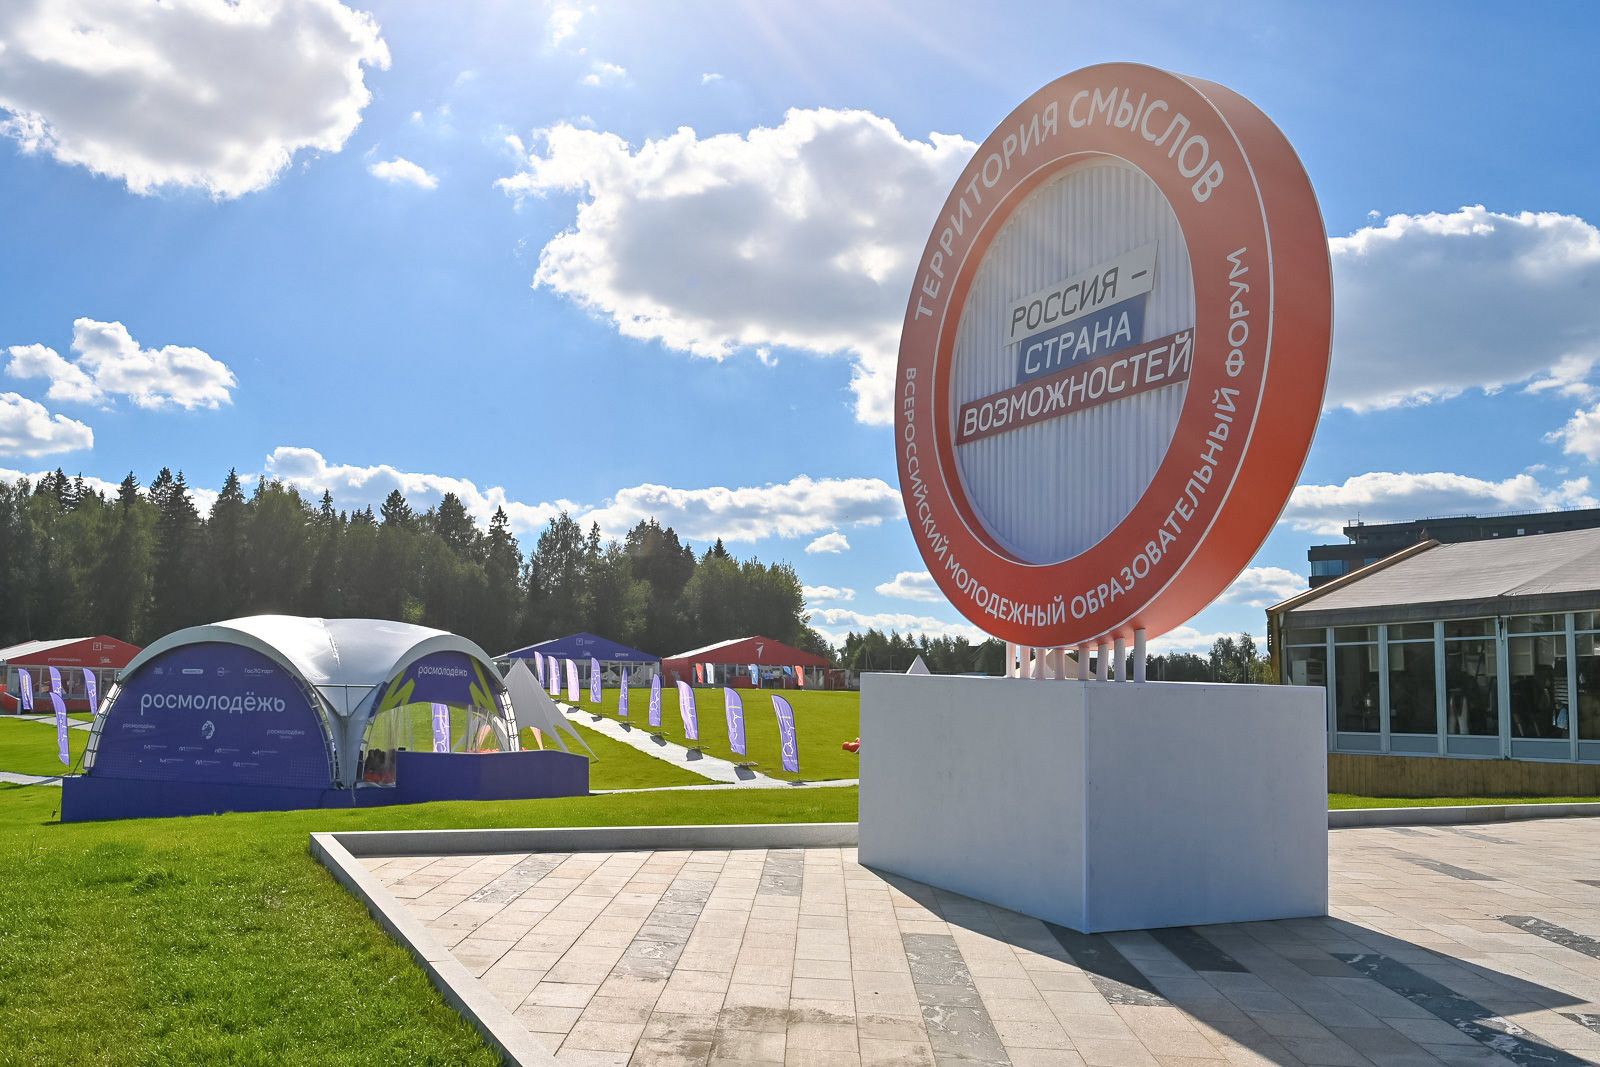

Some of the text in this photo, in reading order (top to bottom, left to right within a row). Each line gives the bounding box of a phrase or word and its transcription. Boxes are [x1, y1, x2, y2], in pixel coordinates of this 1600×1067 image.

[914, 86, 1225, 321] ТЕРРИТОРИЯ СМЫСЛОВ
[1010, 266, 1120, 338] РОССИЯ
[1024, 310, 1133, 376] СТРАНА
[962, 331, 1193, 438] ВОЗМОЖНОСТЕЙ
[902, 246, 1250, 628] ВСЕРОССИЙСКИЙ МОЛОДЕЖНЫЙ ОБРАЗОВАТЕЛЬНЫЙ ФОРУМ
[140, 691, 286, 716] росмолодёжь
